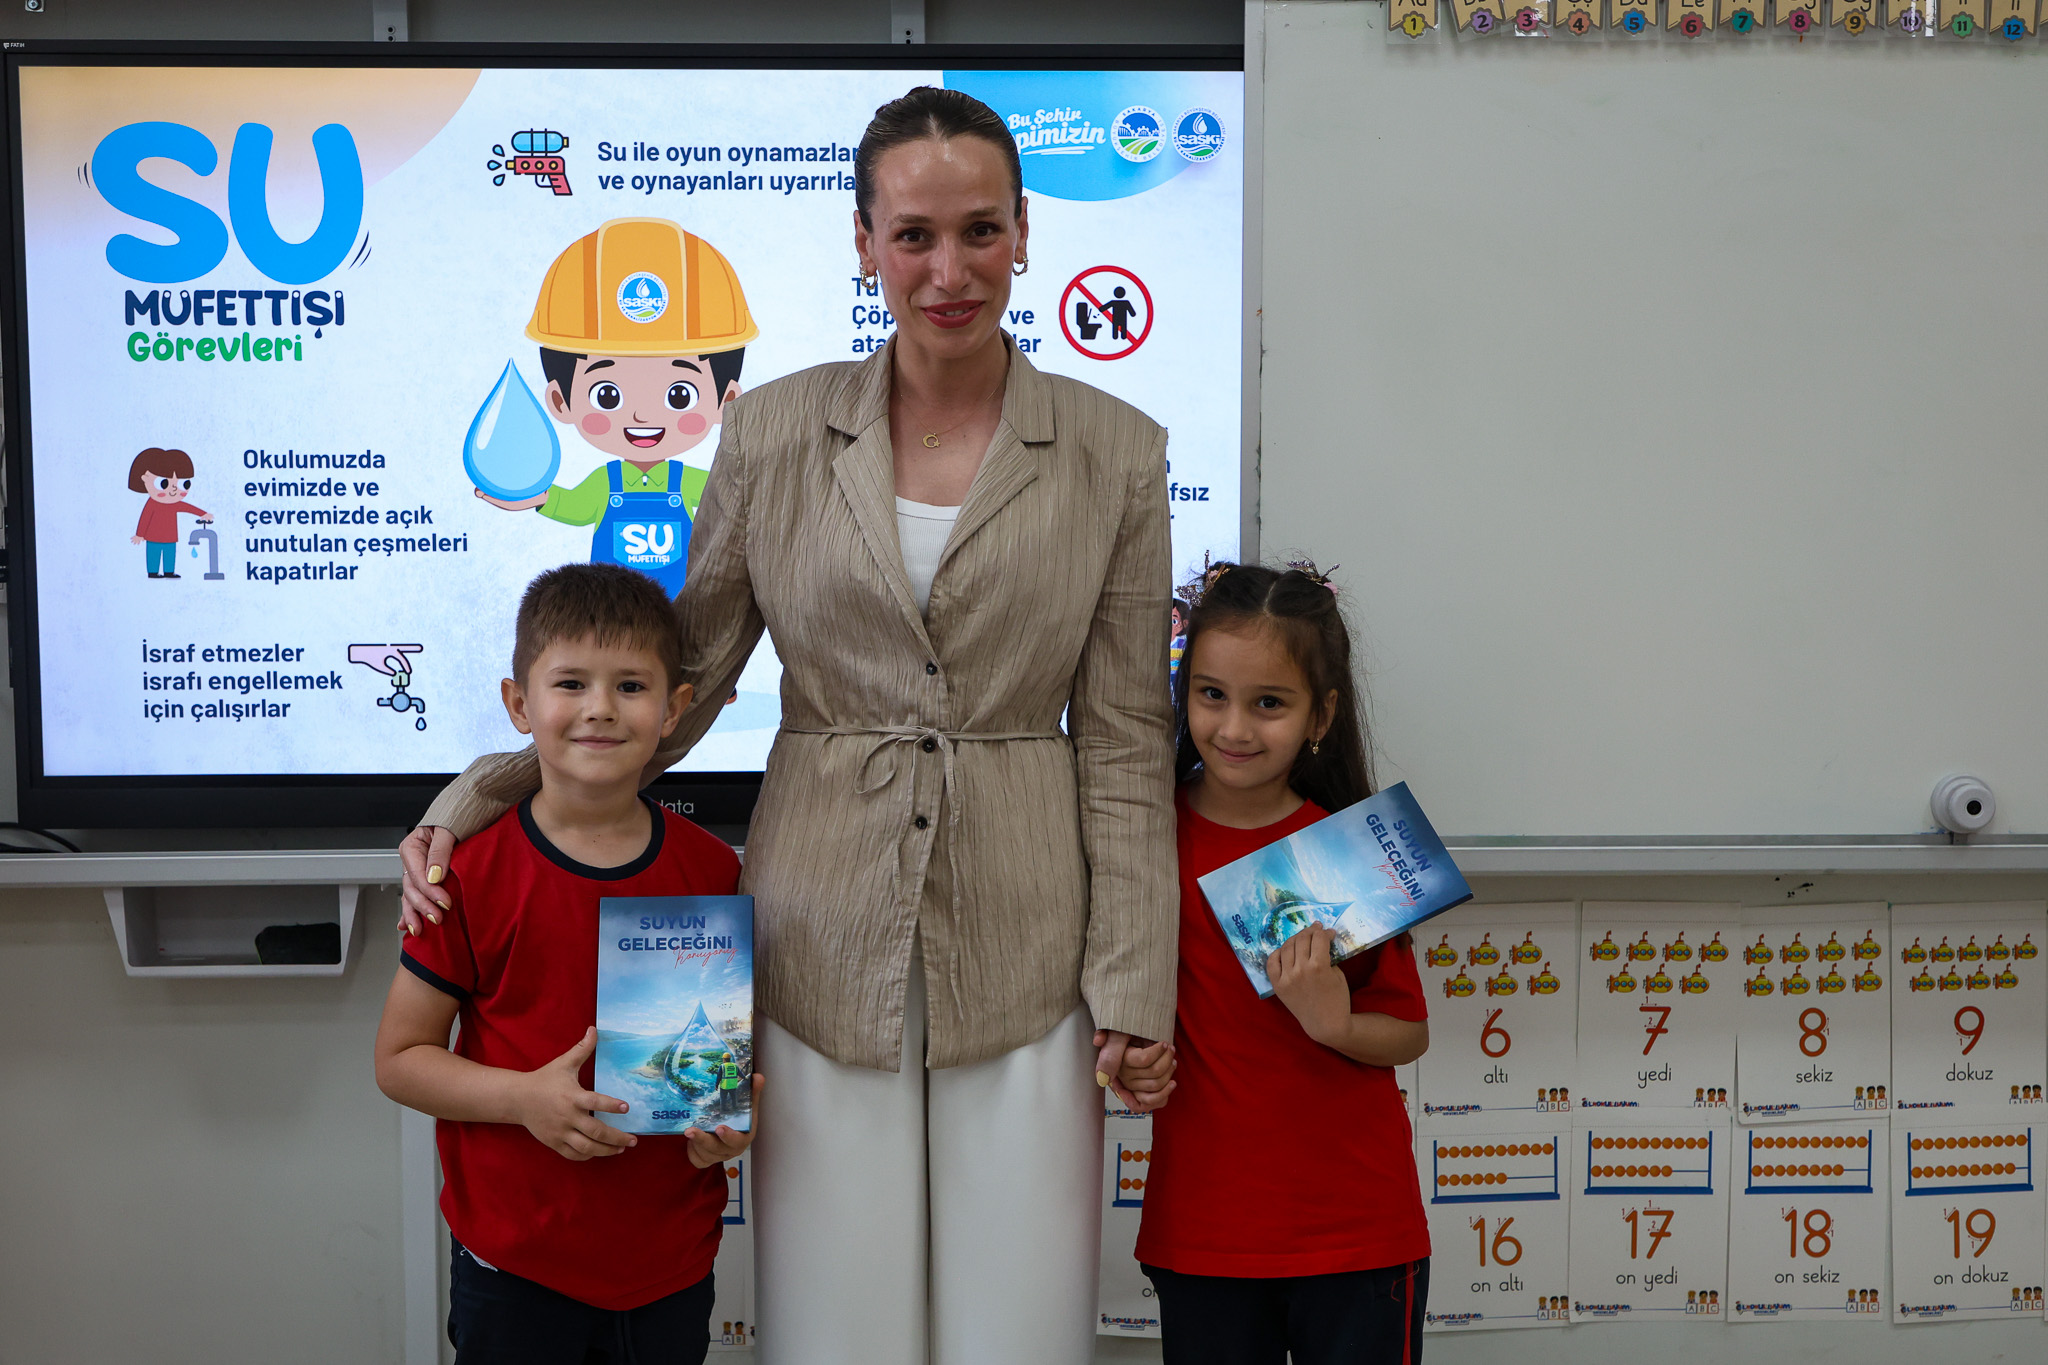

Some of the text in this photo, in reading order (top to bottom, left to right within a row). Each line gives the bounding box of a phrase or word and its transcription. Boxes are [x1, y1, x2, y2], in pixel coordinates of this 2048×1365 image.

[1410, 17, 1417, 31] 1
[1477, 14, 1489, 28] 2
[1522, 13, 1533, 27] 3
[1572, 17, 1584, 31] 4
[1629, 17, 1640, 30] 5
[1685, 20, 1697, 33] 6
[1738, 15, 1748, 29] 7
[1794, 14, 1806, 28] 8
[1849, 16, 1861, 29] 9
[1902, 16, 1919, 28] 10
[1957, 20, 1967, 32] 11
[2006, 24, 2020, 36] 12
[1006, 106, 1083, 130] Bu Şehir
[1014, 121, 1107, 152] pimizin
[598, 142, 626, 162] Su
[633, 142, 660, 162] ile
[666, 146, 721, 167] oyun
[598, 171, 856, 196] ve oynayanları uyarırla
[91, 121, 364, 284] SU
[1009, 310, 1035, 325] ve
[127, 331, 303, 362] Görevleri
[243, 449, 386, 469] Okulumuzda
[244, 477, 379, 497] evimizde ve
[1168, 482, 1209, 502] fsız
[244, 505, 434, 530] çevremizde açık
[245, 532, 468, 557] unutulan çeşmeleri
[622, 523, 674, 555] SU
[246, 561, 358, 585] kapatırlar
[142, 639, 305, 663] İsraf etmezler
[143, 670, 343, 695] israfı engellemek
[144, 698, 291, 723] için çalışırlar
[1366, 813, 1426, 901] GELECEĞİNİ
[1393, 819, 1432, 872] SUYUN
[639, 916, 706, 931] SUYUN
[617, 933, 733, 951] GELECEĞİNİ
[1480, 1008, 1511, 1058] 6
[1638, 1006, 1672, 1056] 7
[1799, 1007, 1827, 1057] 8
[1954, 1006, 1985, 1056] 9
[1483, 1065, 1508, 1084] altı
[1637, 1062, 1672, 1089] yedi
[1796, 1064, 1833, 1084] sekiz
[1946, 1062, 1993, 1081] dokuz
[1473, 1216, 1523, 1267] 16
[1625, 1210, 1675, 1259] 17
[1784, 1208, 1831, 1258] 18
[1947, 1208, 1996, 1259] 19
[1470, 1273, 1523, 1293] on altı
[1616, 1266, 1678, 1292] on yedi
[1774, 1265, 1840, 1284] on sekiz
[1933, 1264, 2009, 1285] on dokuz
